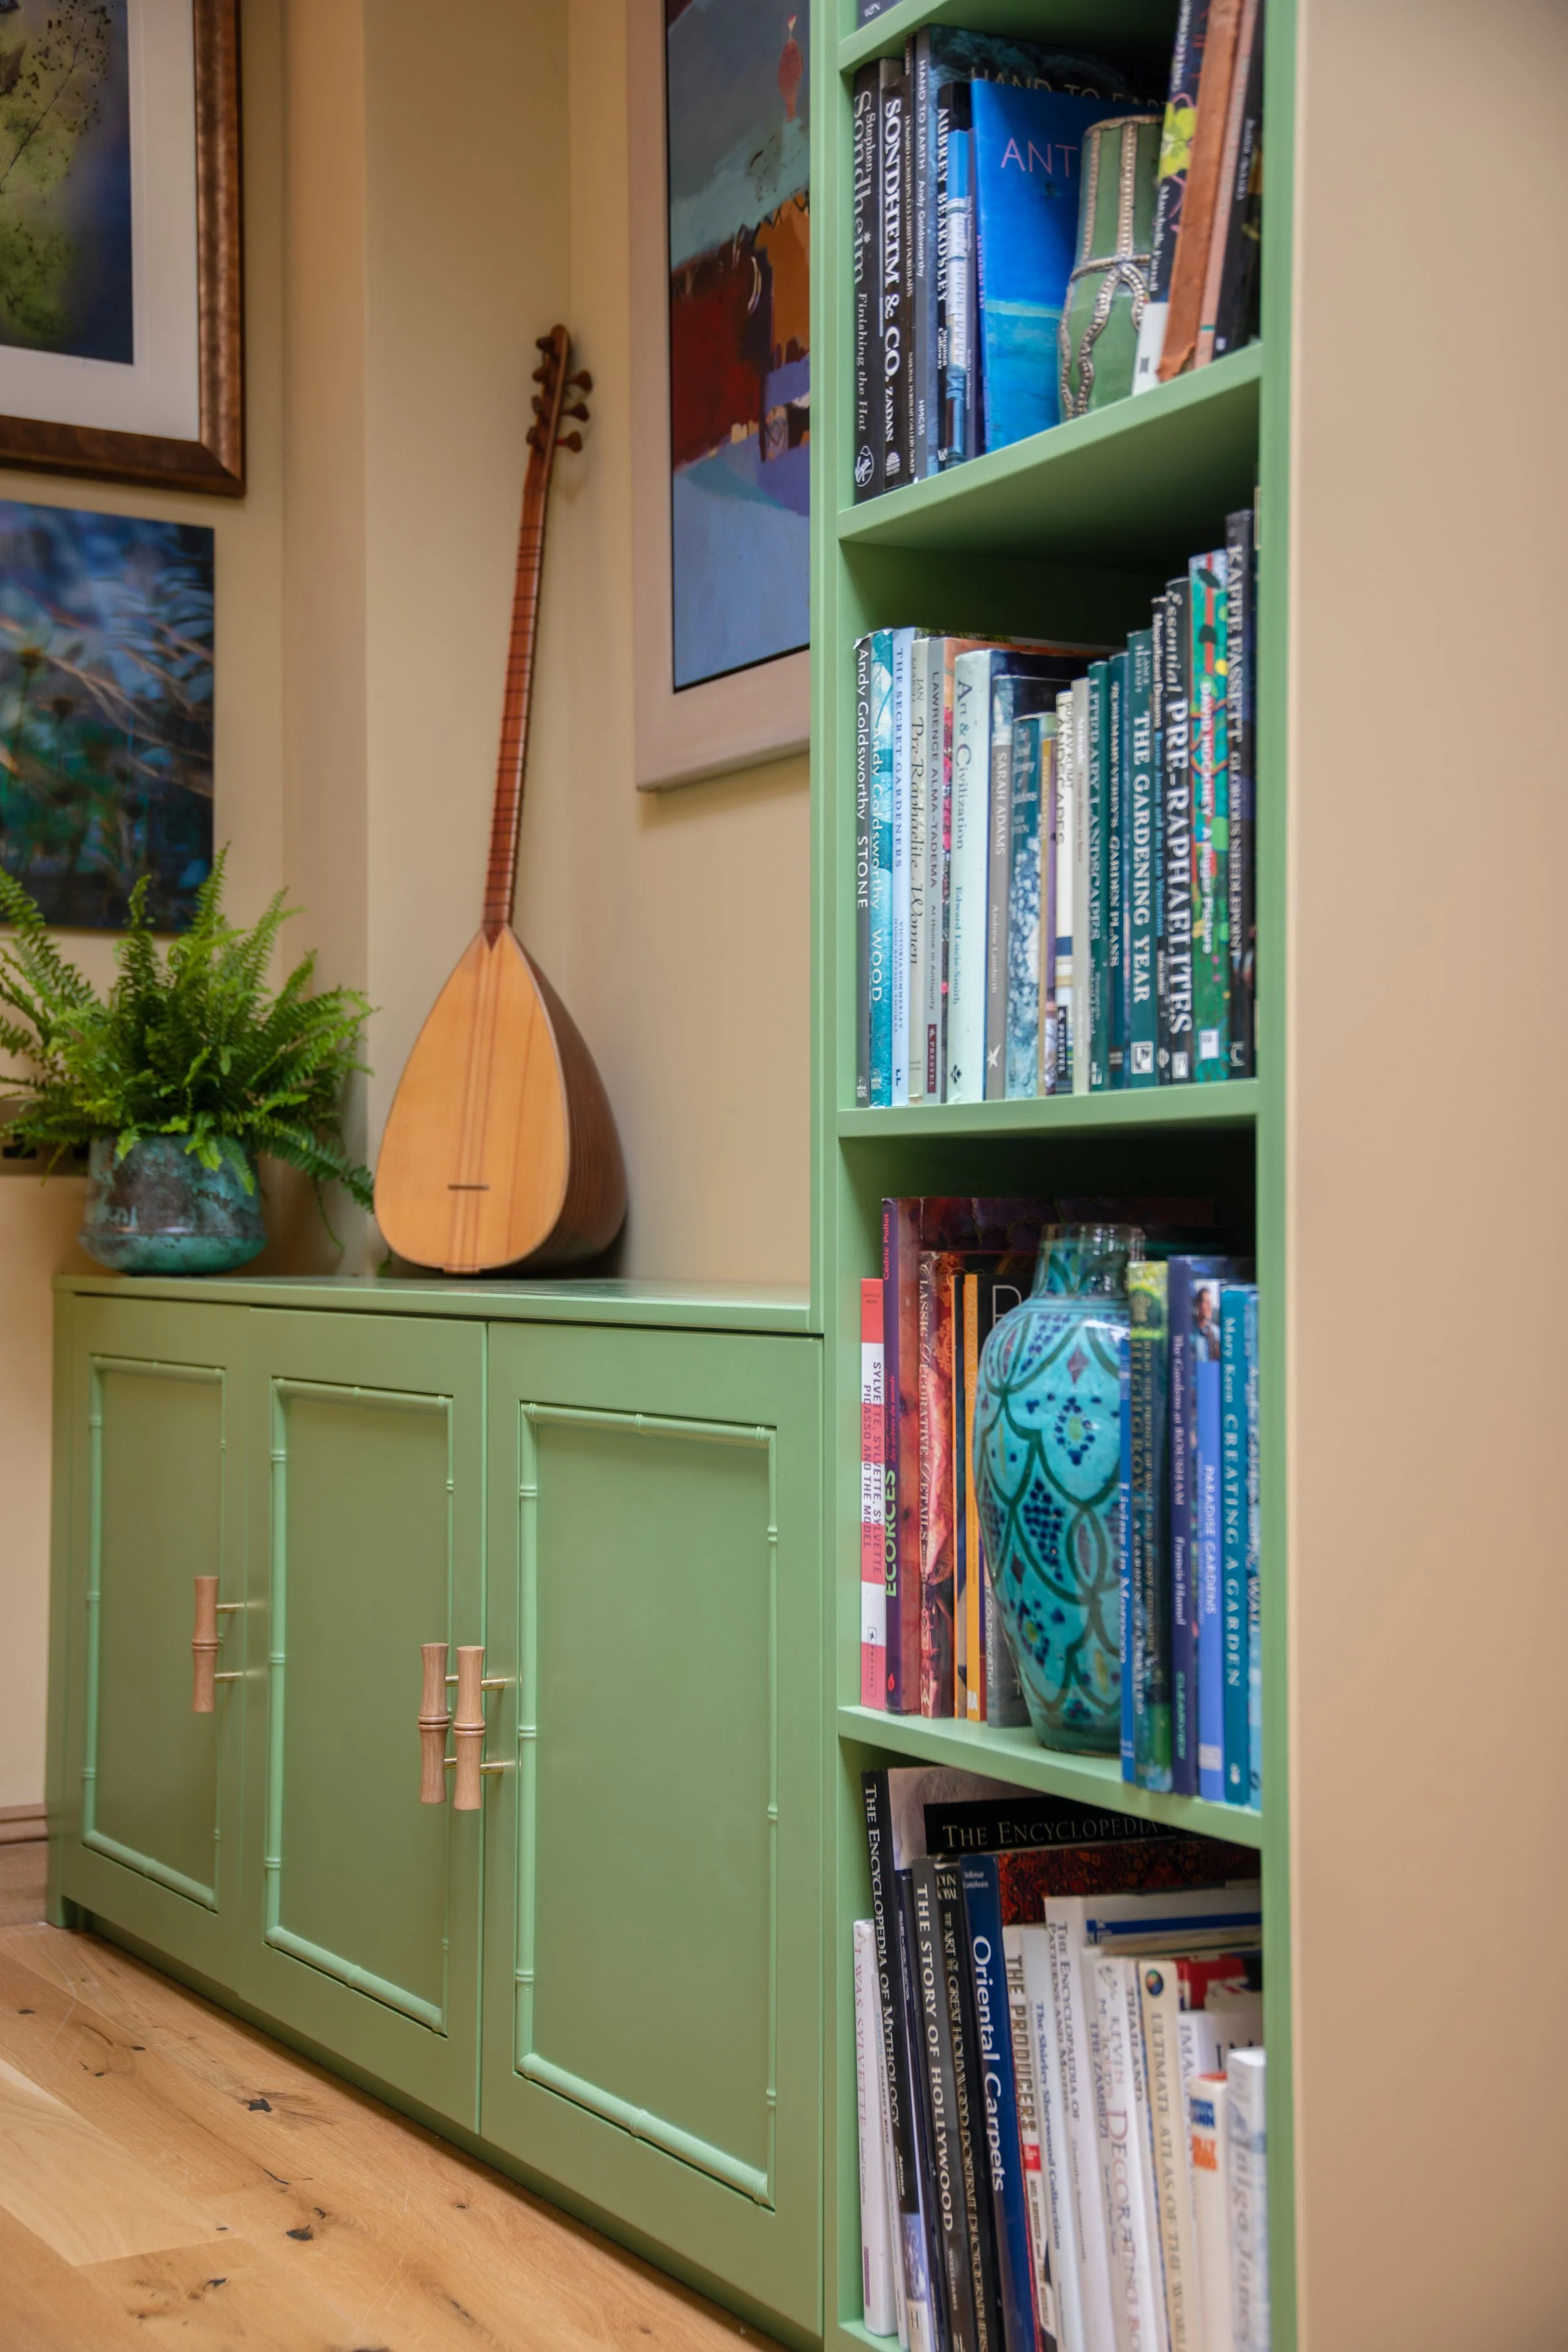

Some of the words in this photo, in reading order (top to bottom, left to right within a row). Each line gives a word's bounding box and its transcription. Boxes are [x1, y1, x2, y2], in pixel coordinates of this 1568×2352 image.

[918, 60, 926, 100] HAND
[864, 113, 876, 172] Stephen
[918, 105, 926, 123] TO
[918, 125, 926, 170] EARTH
[937, 109, 949, 183] AUBREY
[854, 91, 872, 284] Sondheim
[884, 99, 901, 288] SONDHEIM
[916, 181, 926, 207] Andy
[916, 211, 926, 277] Goldsworthy
[936, 192, 950, 302] BEARDSLEY
[856, 292, 868, 366] Finishing
[884, 294, 900, 320] &
[858, 371, 868, 395] the
[884, 326, 901, 383] CO.
[858, 401, 868, 432] Hat
[885, 386, 894, 442] ZADAN
[1227, 544, 1243, 633] KAFFE
[857, 649, 869, 696] Andy
[1152, 613, 1163, 681] Magnificent
[1165, 591, 1182, 692] Essential
[931, 671, 939, 761] LAWRENCE
[956, 680, 973, 716] Art
[1153, 683, 1163, 728] Dreams
[1200, 682, 1212, 726] DAVID
[1227, 635, 1243, 743] FASSETT
[871, 727, 882, 776] Andy
[895, 690, 903, 756] SECRET
[960, 723, 969, 736] &
[1089, 678, 1100, 790] LITERARY
[1110, 682, 1120, 763] ROSEMARY
[1133, 711, 1150, 766] THE
[857, 702, 869, 820] Goldsworthy
[996, 753, 1007, 800] SARAH
[1056, 703, 1065, 845] LANDSCAPES
[1200, 731, 1213, 815] HOCKNEY
[894, 763, 903, 867] GARDENERS
[910, 718, 925, 868] Pre-Raphaelite
[955, 744, 972, 850] Civilization
[1109, 766, 1120, 828] VEREY'S
[1155, 807, 1163, 827] and
[1229, 751, 1242, 837] GLORIOUS
[871, 784, 883, 909] Goldsworthy
[930, 768, 938, 888] ALMA-TADEMA
[995, 805, 1006, 856] ADAMS
[1133, 773, 1150, 925] GARDENING
[1155, 830, 1163, 849] the
[1202, 828, 1212, 840] A
[857, 836, 869, 909] STONE
[1089, 797, 1100, 940] LANDSCAPES
[1109, 835, 1120, 907] GARDEN
[1155, 852, 1164, 877] Late
[1165, 697, 1192, 1034] PRE-RAPHAELITES
[1199, 845, 1212, 893] Bigger
[910, 882, 924, 965] Women
[930, 904, 937, 916] At
[955, 886, 963, 930] Edward
[991, 904, 1000, 944] Andrew
[1155, 880, 1165, 937] Victorians
[1202, 896, 1214, 953] Picture
[1229, 839, 1242, 960] NEEDLEPOINT
[872, 930, 882, 1001] WOOD
[953, 935, 962, 1005] Lucie-Smith
[990, 947, 999, 993] Lambirth
[1109, 911, 1120, 967] PLANS
[1133, 936, 1150, 1003] YEAR
[929, 963, 937, 1010] Antiquity
[1057, 1024, 1066, 1073] PRESTEL
[1173, 1333, 1184, 1357] The
[1224, 1317, 1236, 1359] Mary
[862, 1384, 871, 1439] PICASSO
[872, 1362, 882, 1430] SYLVETTE,
[889, 1404, 896, 1416] du
[1143, 1380, 1152, 1402] THE
[1173, 1359, 1184, 1411] Gardens
[1224, 1364, 1236, 1402] Keen
[1143, 1404, 1153, 1450] PRINCE
[1173, 1412, 1183, 1424] at
[863, 1444, 871, 1470] AND
[863, 1476, 871, 1500] THE
[872, 1436, 882, 1505] SYLVETTE,
[1144, 1453, 1153, 1469] OF
[1173, 1426, 1185, 1505] ROUSHAM
[1224, 1413, 1239, 1545] CREATING
[919, 1456, 932, 1540] DETAILS
[1118, 1483, 1130, 1544] Living
[1144, 1472, 1153, 1511] WALES
[1205, 1465, 1216, 1537] PARADISE
[863, 1505, 871, 1549] MODEL
[872, 1510, 882, 1575] SYLVETTE
[1174, 1536, 1186, 1581] Francis
[1119, 1550, 1129, 1570] in
[1145, 1544, 1153, 1587] BUNNY
[1205, 1540, 1216, 1614] GARDENS
[1225, 1555, 1239, 1570] A
[985, 1598, 994, 1688] GOLDSWORTHY
[1118, 1577, 1130, 1664] Morocco
[1145, 1588, 1155, 1652] GUINNESS
[1225, 1578, 1241, 1687] GARDEN
[1175, 1671, 1186, 1760] CLEARVIEW
[865, 1784, 877, 1823] THE
[879, 1973, 890, 1999] OF
[916, 1884, 931, 1932] THE
[944, 1929, 956, 1956] ART
[1057, 1922, 1068, 1956] THE
[854, 1964, 863, 2007] WAS
[920, 1941, 938, 2018] STORY
[946, 1976, 961, 2023] GREAT
[973, 1936, 1000, 2060] Oriental
[1010, 1955, 1025, 1994] THE
[1047, 1923, 1061, 2003] PATTERNS
[1056, 2006, 1064, 2043] AND
[928, 2024, 940, 2058] OF
[1036, 2002, 1045, 2032] The
[1059, 1960, 1078, 2094] ENCYCLOPAEDIA
[1089, 2022, 1101, 2057] THE
[1126, 1986, 1144, 2102] THAILAND
[856, 2017, 867, 2127] SYLVETTE
[951, 2026, 968, 2127] HOLLYWOOD
[1010, 2004, 1037, 2132] PRODUCERS
[1037, 2035, 1048, 2085] Shirley
[1109, 2015, 1125, 2084] KEVIN
[1151, 2011, 1171, 2117] ULTIMATE
[1042, 2090, 1056, 2167] Sherwood
[1071, 2100, 1080, 2122] OF
[1093, 2060, 1110, 2139] ZAMBEZI
[931, 2067, 953, 2232] HOLLYWOOD
[984, 2072, 1006, 2192] Carpets
[1160, 2125, 1176, 2190] ATLAS
[960, 2130, 977, 2211] PORTRAIT
[1048, 2170, 1061, 2250] Collection
[1107, 2109, 1140, 2306] DECORATING
[1166, 2193, 1179, 2226] OF
[948, 2247, 958, 2312] WILLIAMS
[1167, 2231, 1182, 2275] THE
